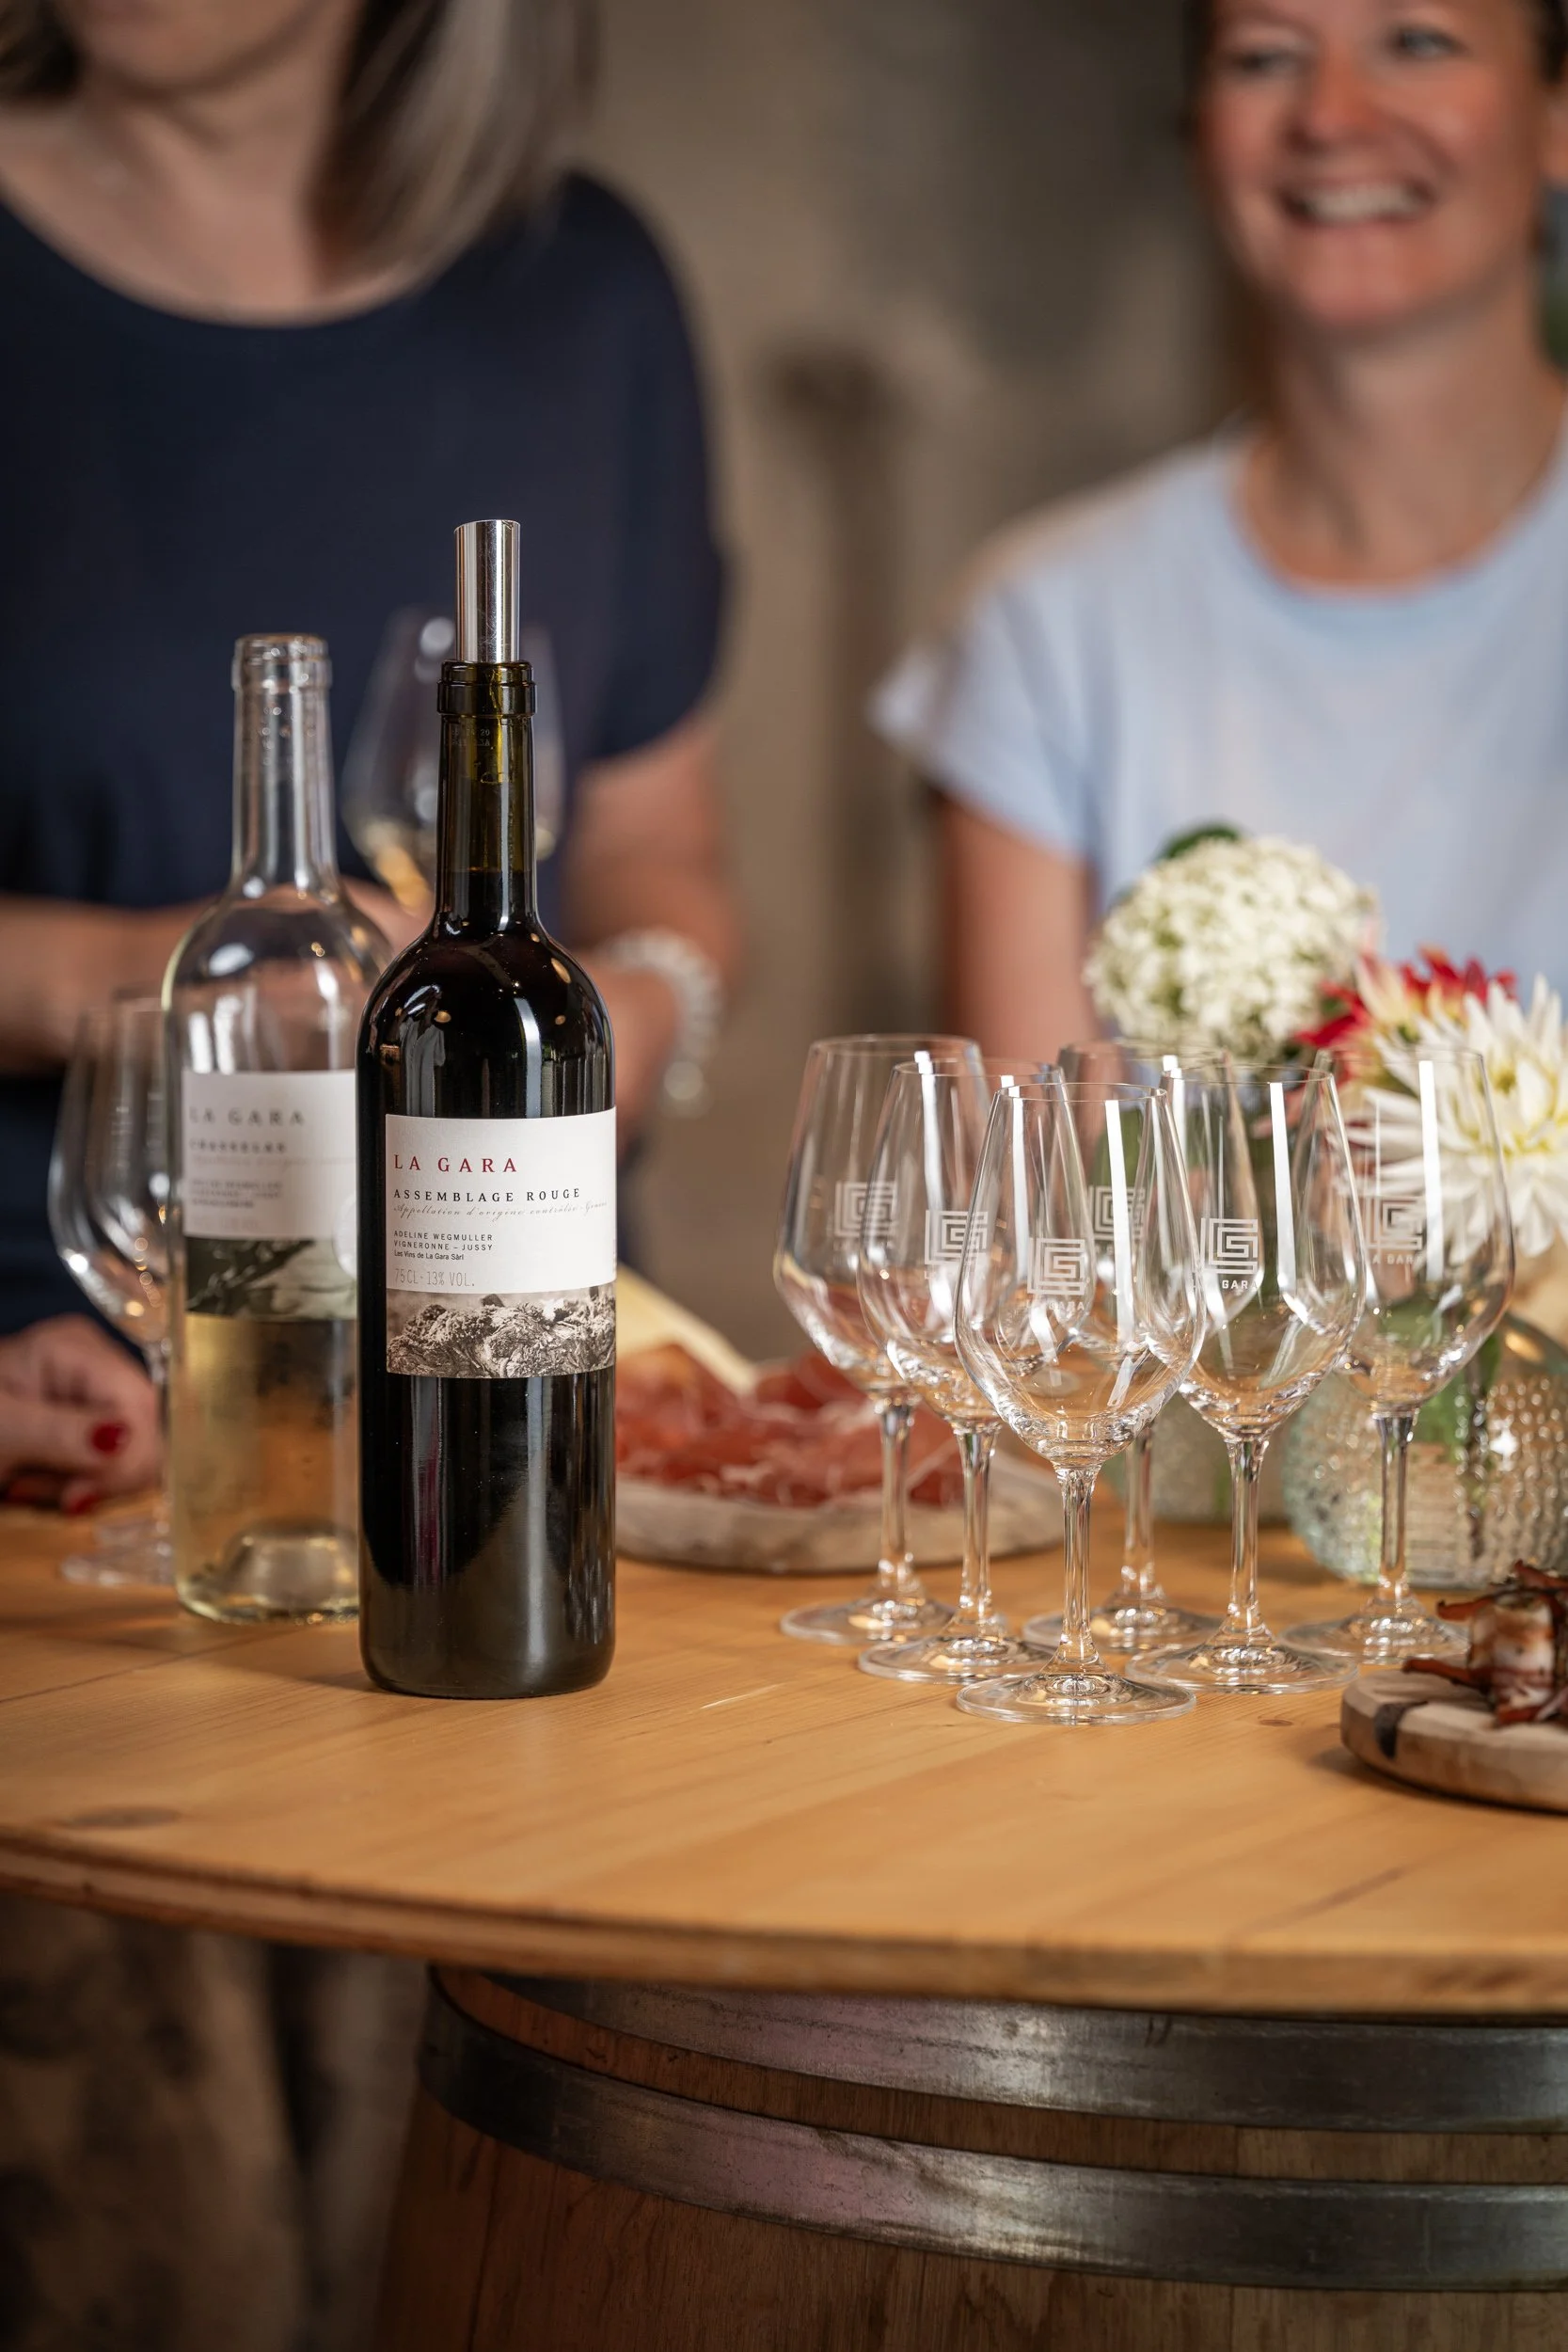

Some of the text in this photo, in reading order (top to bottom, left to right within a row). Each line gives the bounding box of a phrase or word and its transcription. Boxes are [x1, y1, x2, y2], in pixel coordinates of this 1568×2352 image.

[189, 1107, 305, 1126] LA GARA
[393, 1154, 516, 1172] LA GARA
[393, 1188, 579, 1202] ASSEMBLAGE ROUGE
[393, 1203, 460, 1219] Appellation
[393, 1230, 428, 1239] ADELINE
[393, 1239, 450, 1250] VIGNERONNE
[449, 1271, 475, 1287] VOL.
